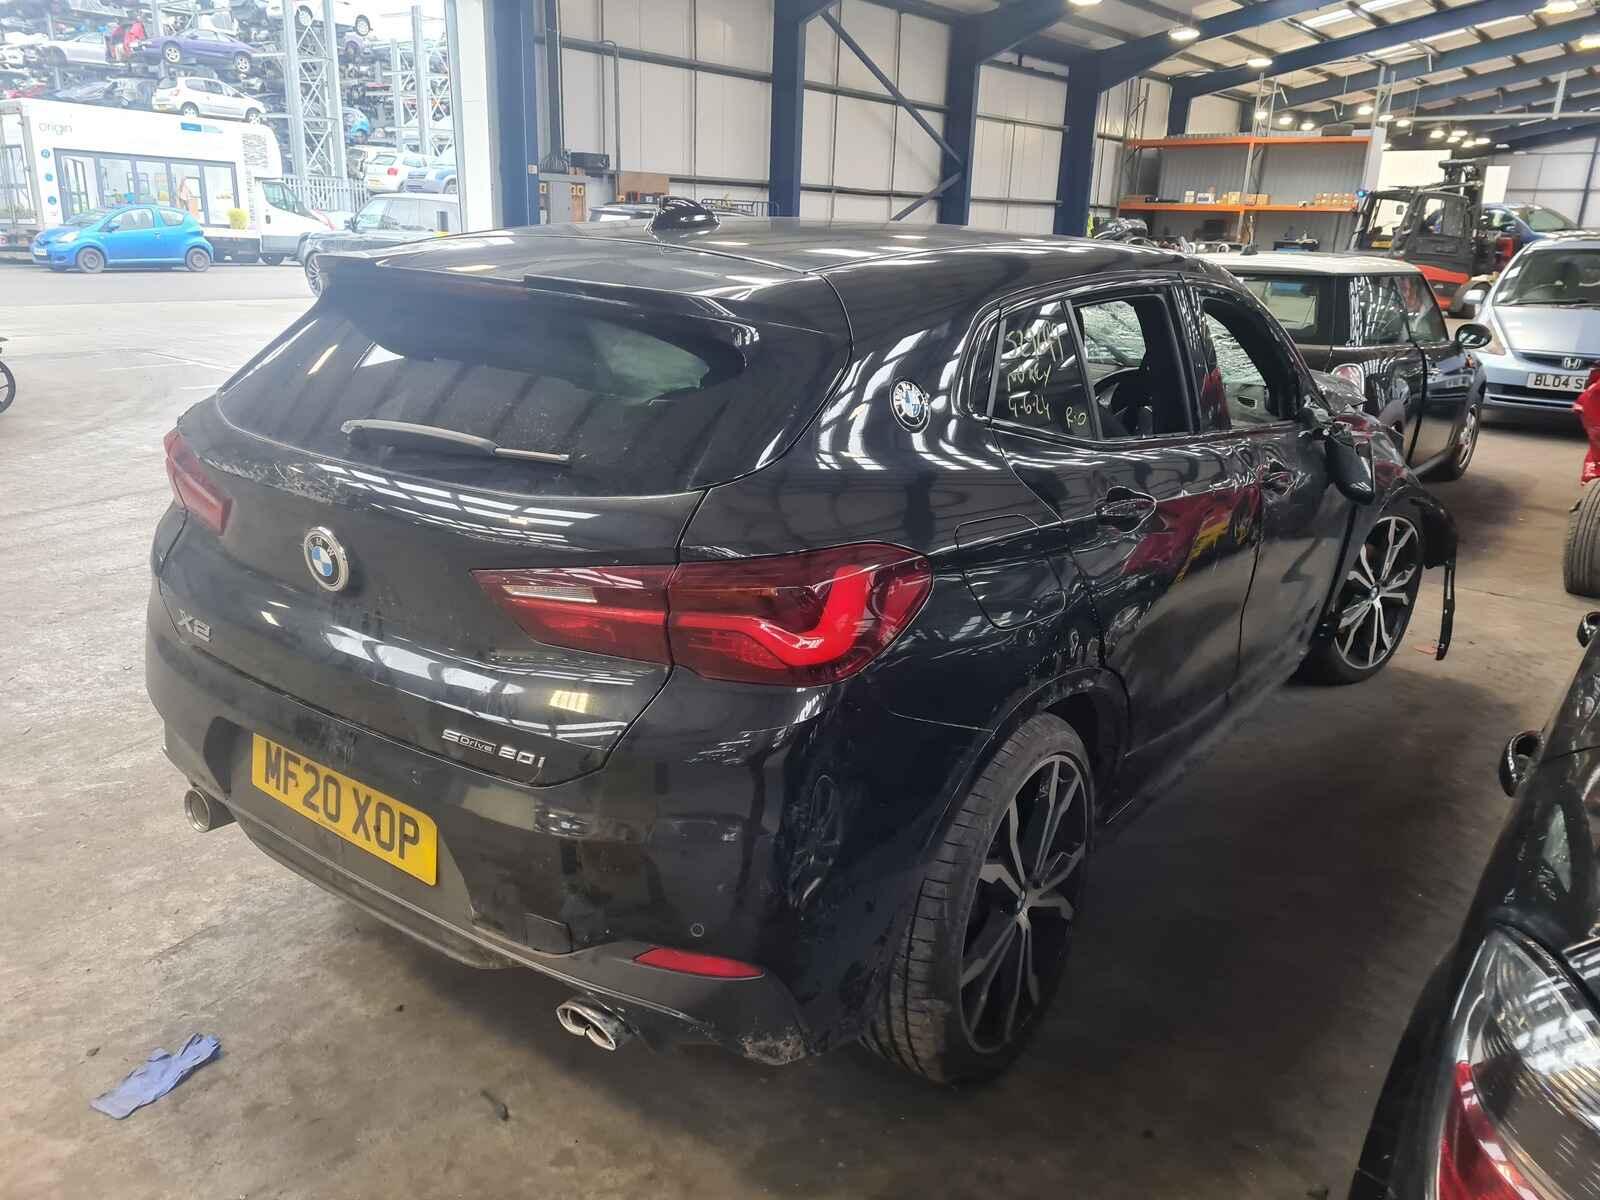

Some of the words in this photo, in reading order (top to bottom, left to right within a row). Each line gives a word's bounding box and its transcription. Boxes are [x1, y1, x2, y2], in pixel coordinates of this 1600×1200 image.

[1534, 374, 1570, 388] BL04
[177, 608, 210, 642] X2
[264, 741, 341, 823] MF20
[352, 787, 420, 859] XOP
